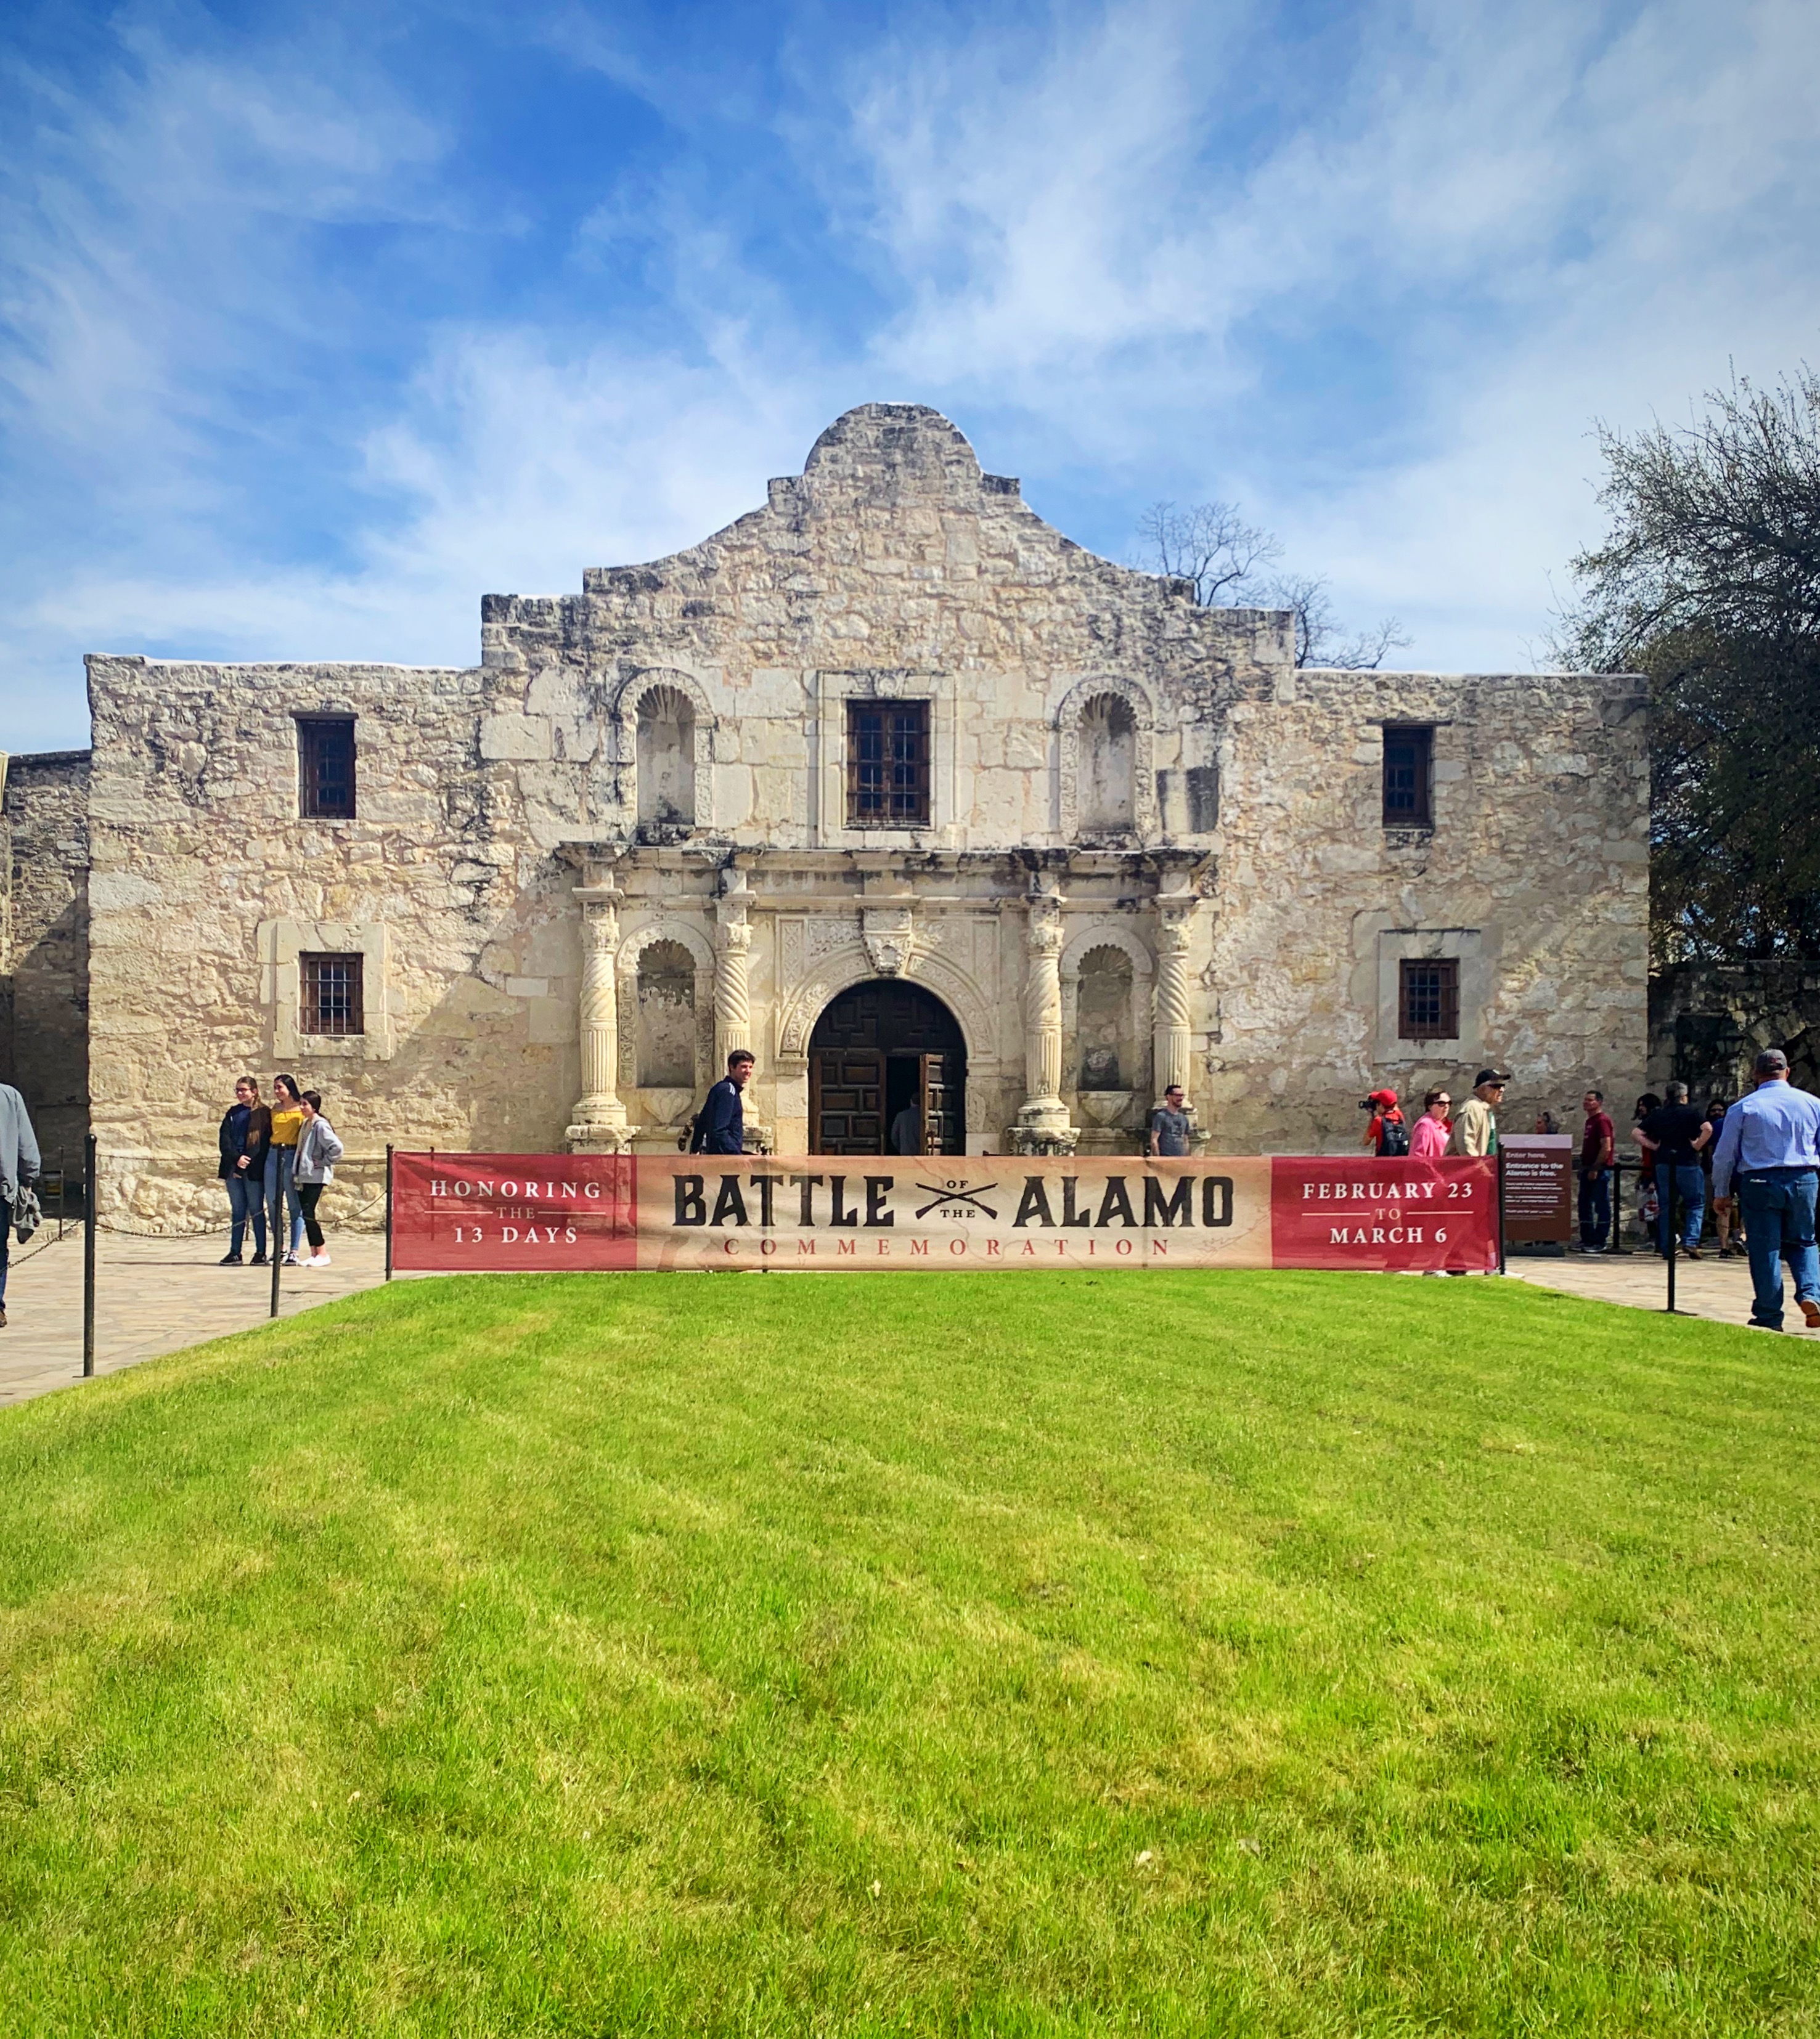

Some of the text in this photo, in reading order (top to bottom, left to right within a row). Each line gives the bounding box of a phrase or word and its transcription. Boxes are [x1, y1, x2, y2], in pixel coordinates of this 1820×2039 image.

[430, 1180, 602, 1199] HONORING
[1302, 1182, 1474, 1199] FEBRUARY 23
[672, 1174, 1233, 1227] BATTLE OF THE ALAMO
[496, 1207, 536, 1219] THE
[1375, 1208, 1401, 1220] TO
[454, 1227, 577, 1244] 13 DAYS
[1329, 1227, 1447, 1244] MARCH 6
[724, 1239, 1170, 1256] COMMEMORATION
